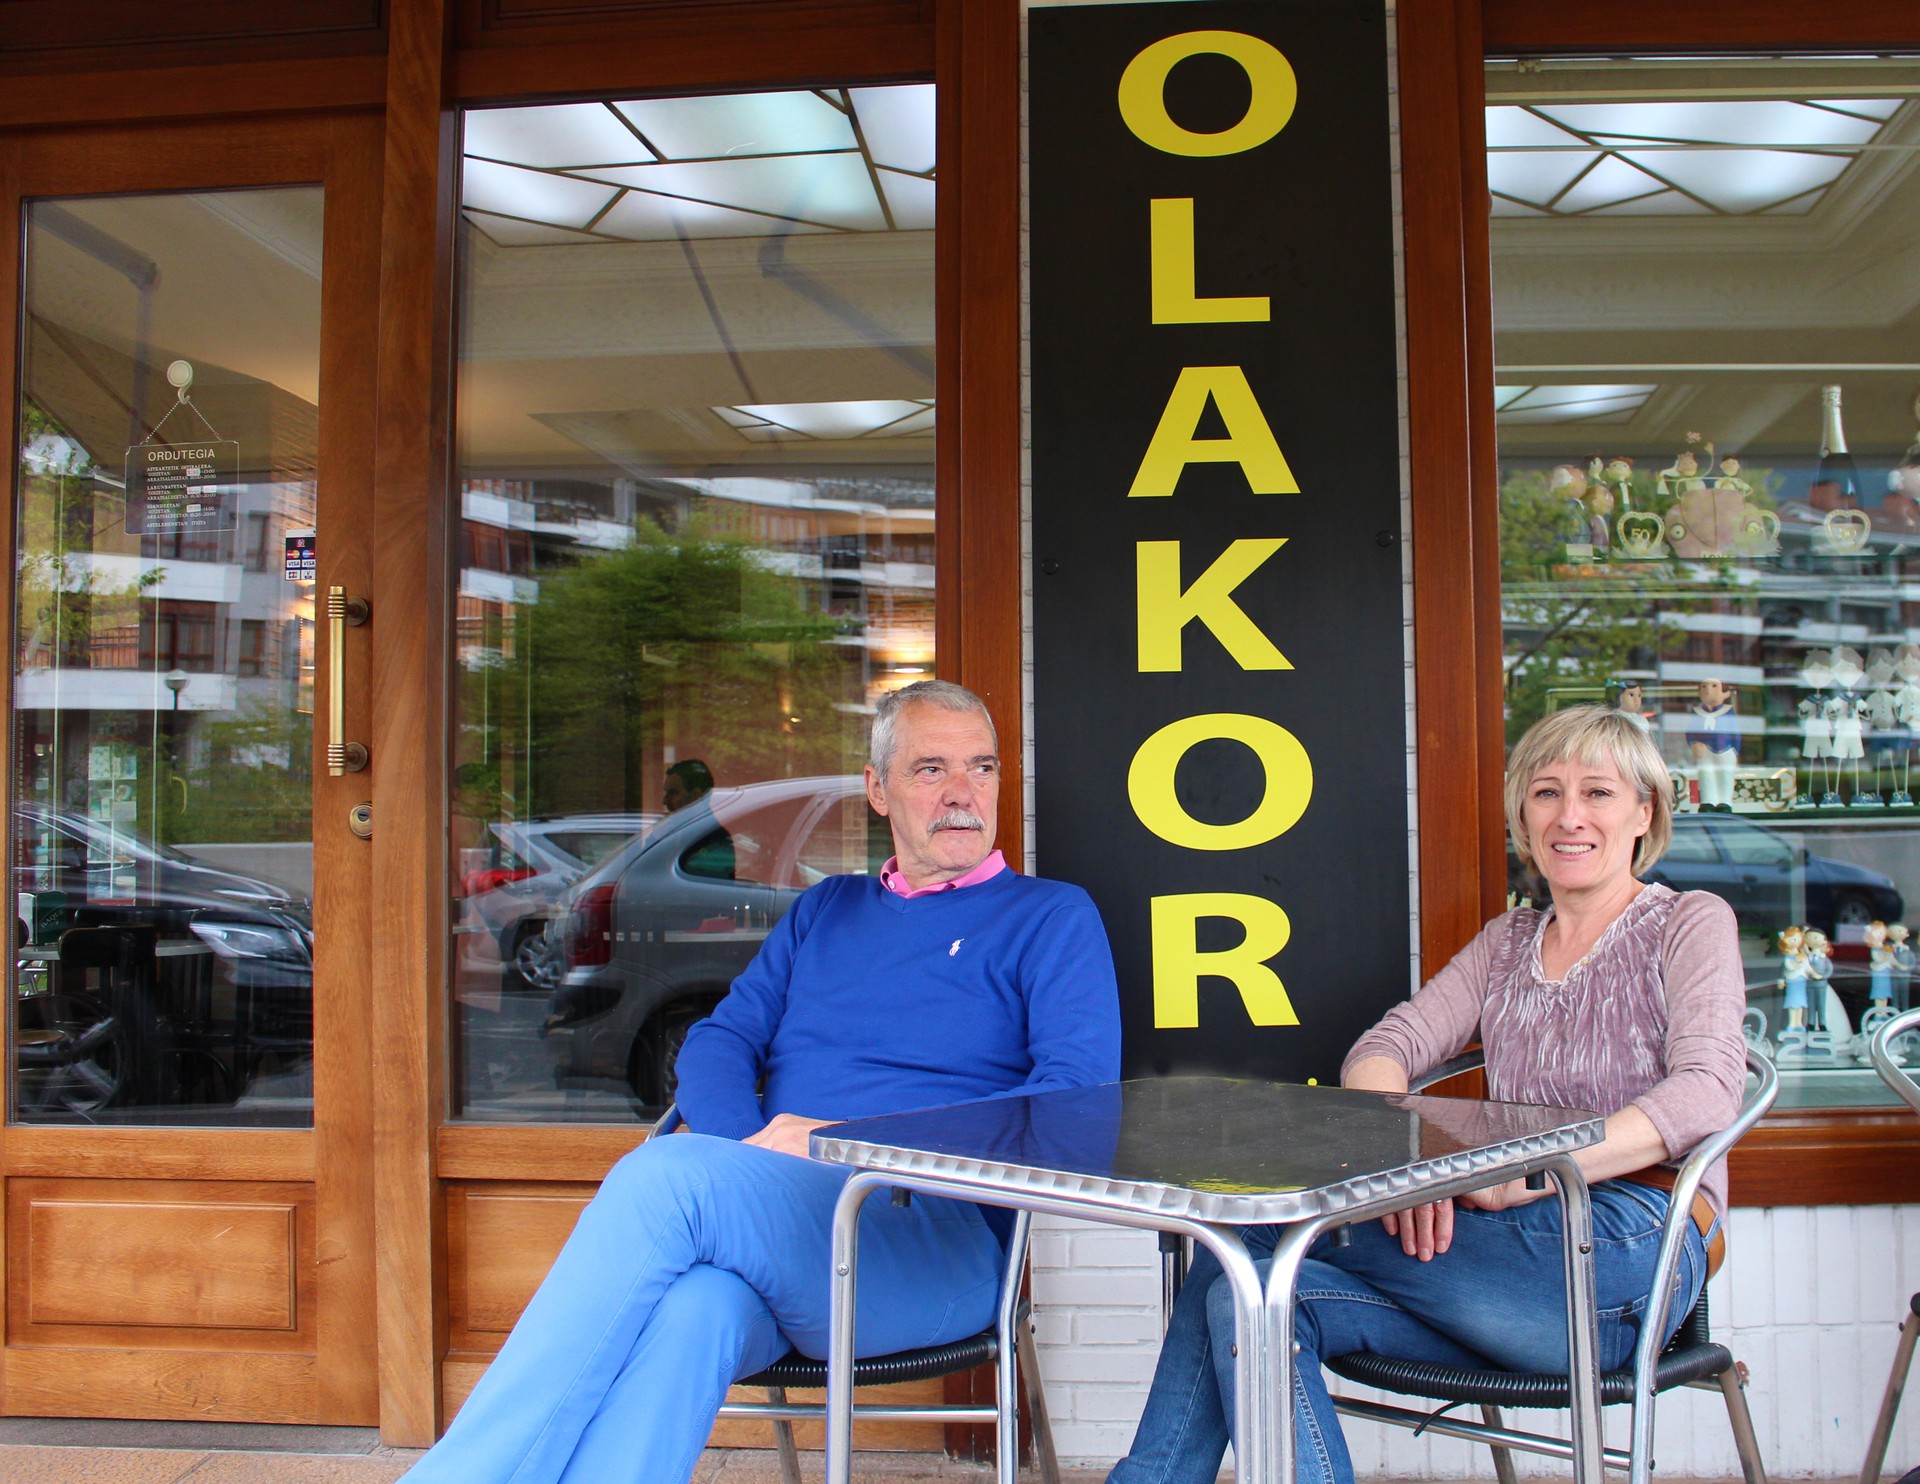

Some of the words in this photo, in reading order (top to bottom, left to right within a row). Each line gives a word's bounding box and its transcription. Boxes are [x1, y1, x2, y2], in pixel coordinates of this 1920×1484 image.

[148, 449, 215, 461] ORDUTEGIA
[1118, 30, 1313, 1029] OLAKOR
[1631, 528, 1650, 542] 50
[1776, 1030, 1837, 1063] 25
